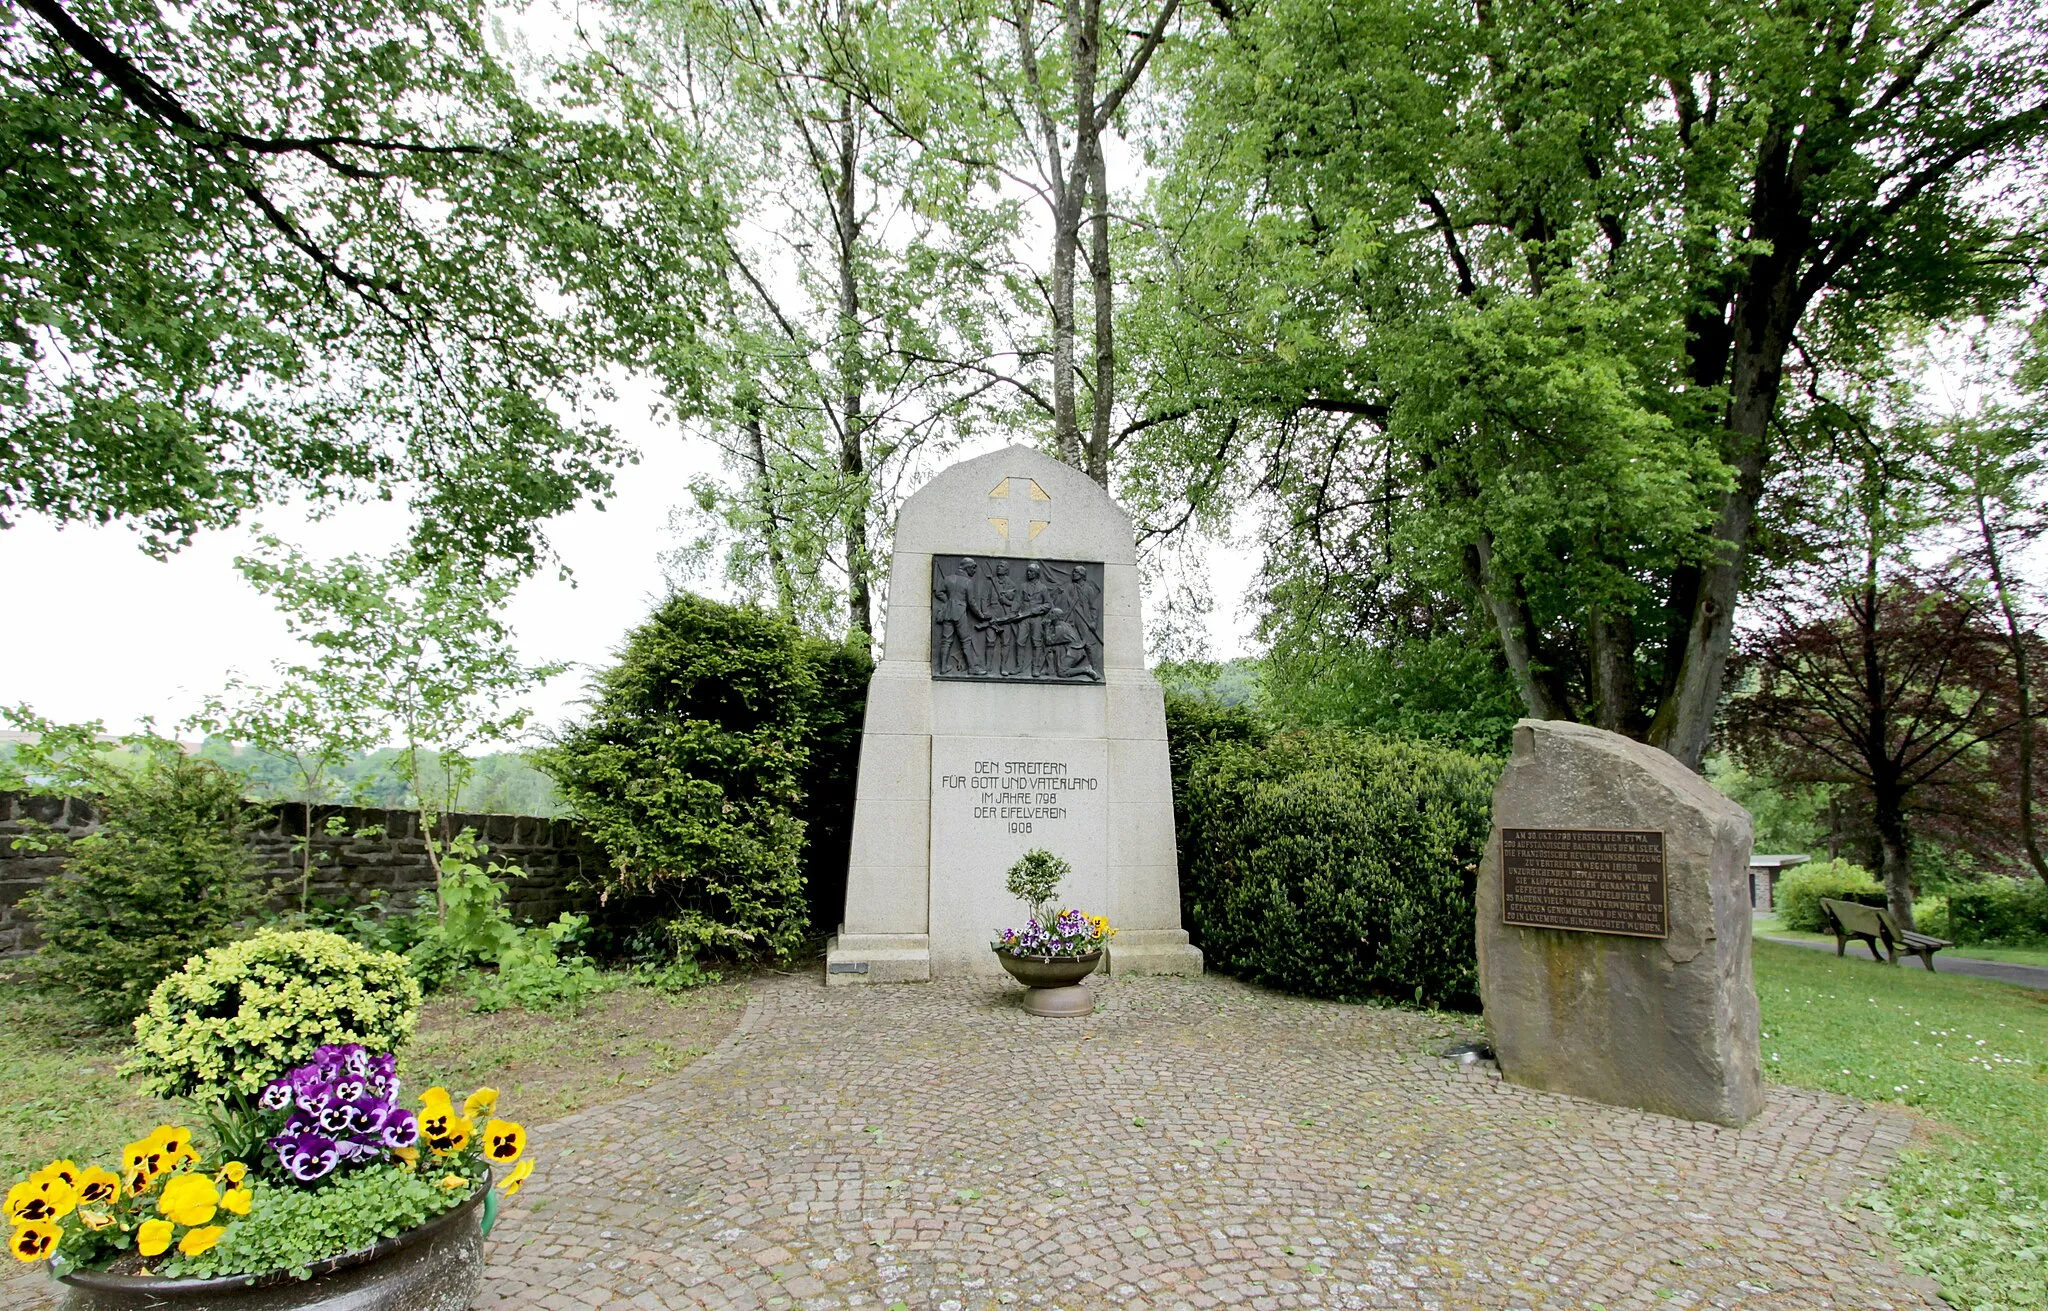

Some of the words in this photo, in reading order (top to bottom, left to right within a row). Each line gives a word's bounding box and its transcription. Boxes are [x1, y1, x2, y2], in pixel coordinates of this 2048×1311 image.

[975, 762, 998, 773] DEN
[1005, 762, 1067, 774] STREITERN
[943, 776, 966, 788] FÜR
[971, 777, 999, 788] GOTT
[1002, 778, 1027, 789] UND
[1030, 778, 1097, 790] VATERLAND
[982, 793, 993, 803] IM
[996, 793, 1031, 804] JAHRE
[1036, 793, 1056, 804] 1798
[974, 807, 996, 818] DER
[1001, 808, 1066, 818] EIFELVEREIN
[1008, 823, 1032, 833] 1908
[1518, 850, 1568, 858] FRANZÖSISCHE
[1570, 852, 1661, 862] REVOLUTIONSBESATZUNG
[1509, 868, 1569, 877] UNZUREICHENDEN
[1572, 871, 1622, 880] BEWAFFNUNG
[1625, 874, 1657, 882] WURDEN
[1515, 886, 1547, 894] GEFECHT
[1549, 888, 1584, 896] WESTLICH
[1587, 890, 1620, 899] ARZFELD
[1622, 892, 1650, 901] FIELEN
[1566, 898, 1596, 907] WURDEN
[1598, 900, 1645, 910] VERWUNDET
[1648, 904, 1663, 912] UND
[1510, 904, 1545, 912] GEFANGEN
[1607, 911, 1633, 919] DENEN
[1637, 913, 1658, 922] NOCH
[1526, 914, 1568, 924] LUXEMBURG
[1571, 917, 1625, 928] HINGERICHTET
